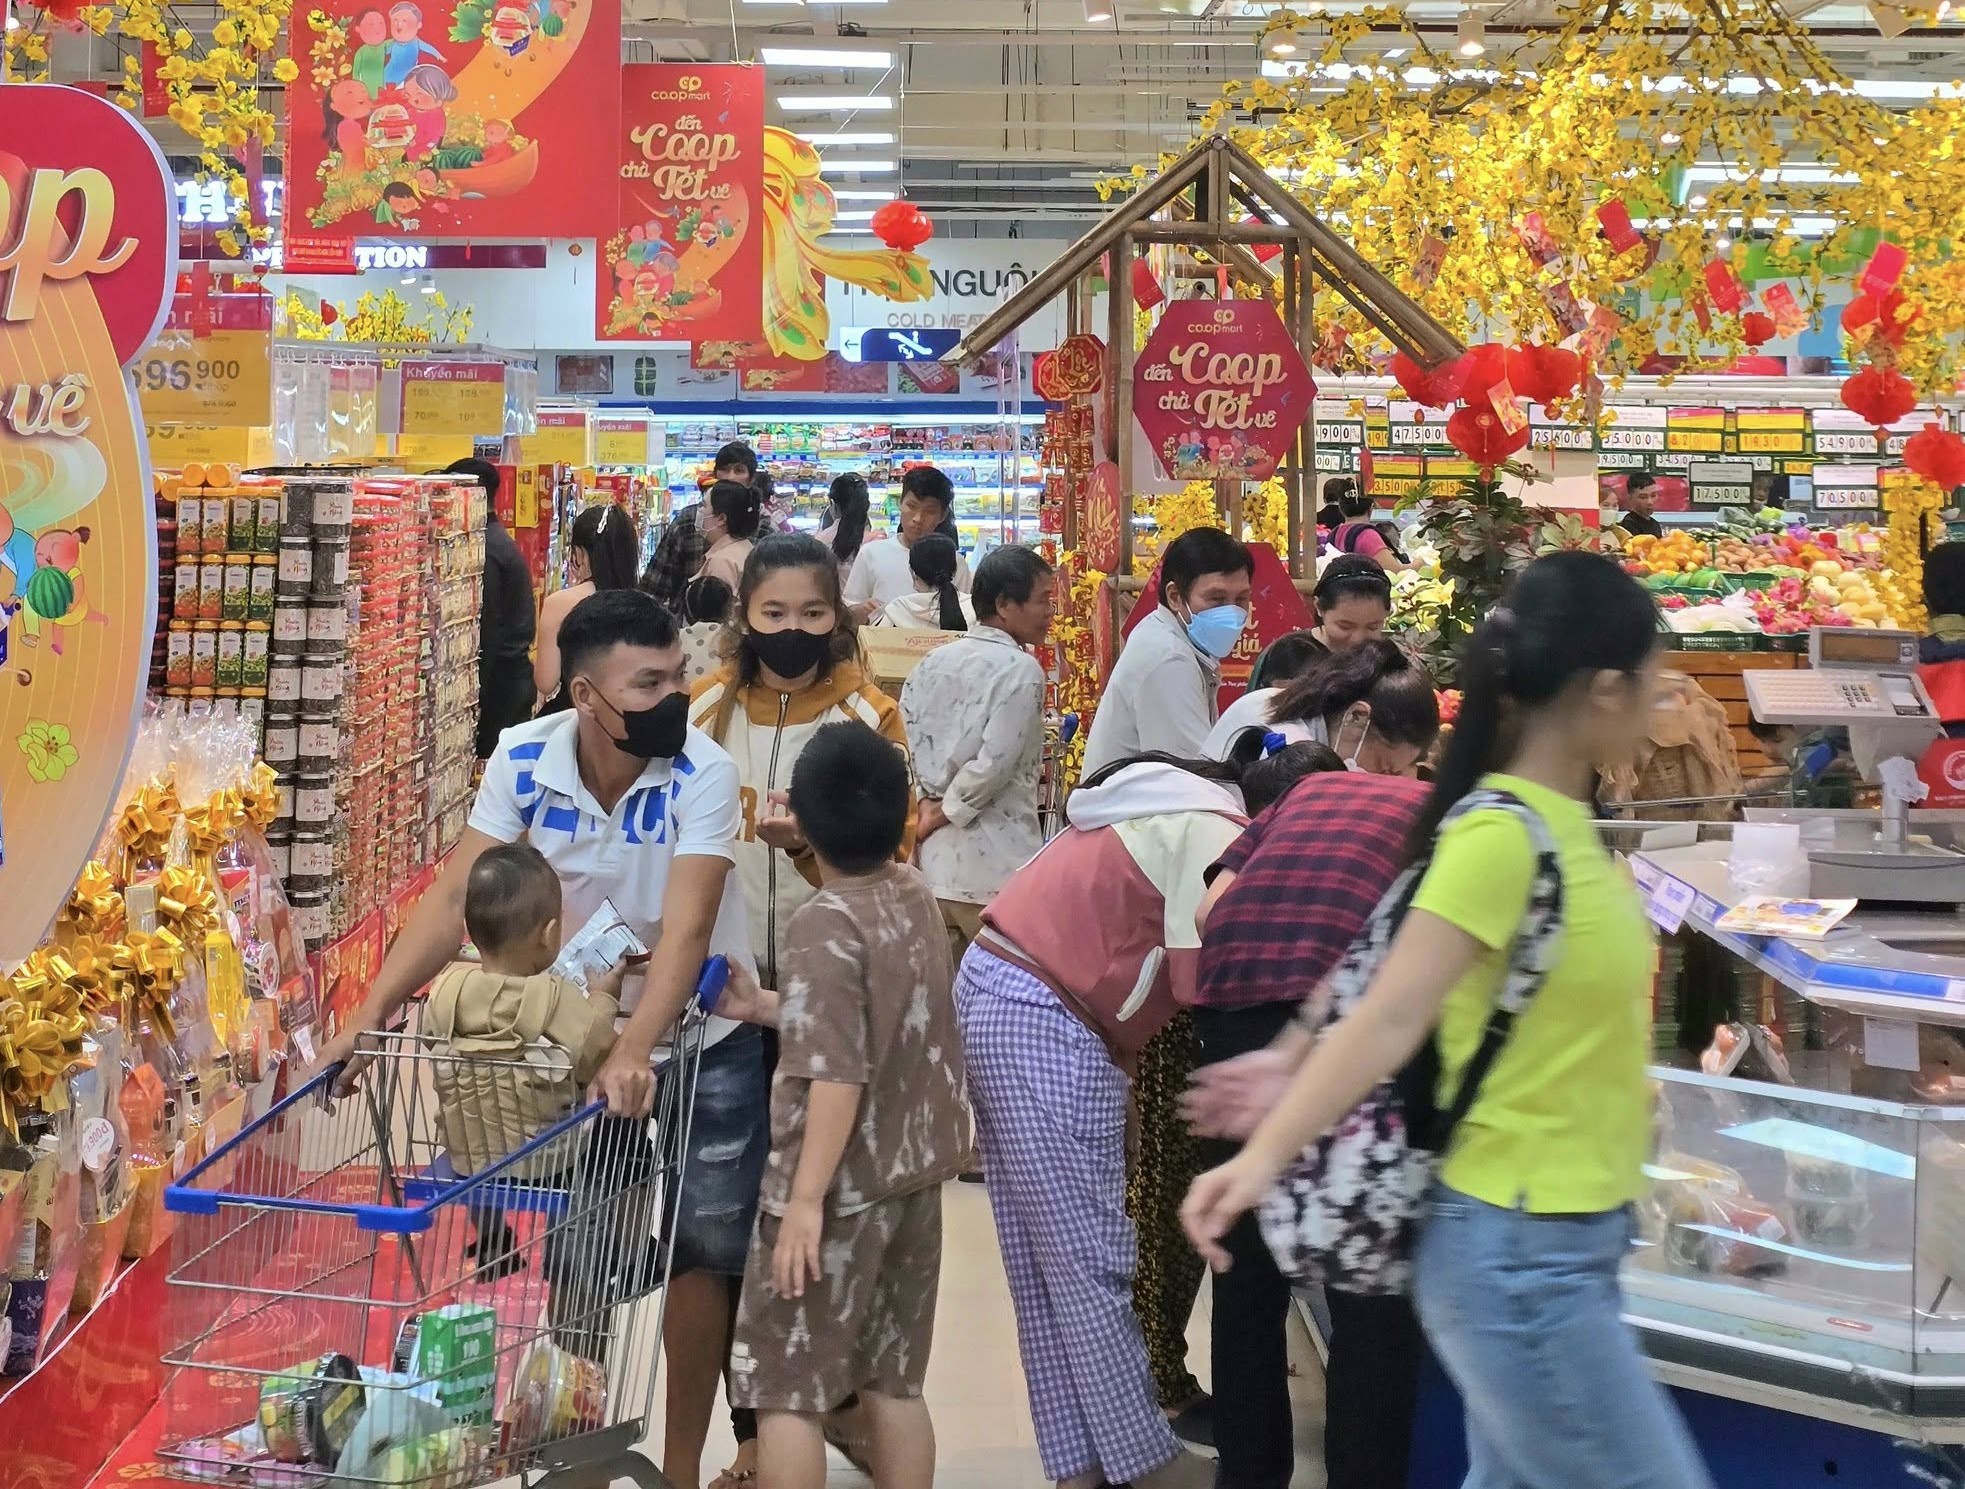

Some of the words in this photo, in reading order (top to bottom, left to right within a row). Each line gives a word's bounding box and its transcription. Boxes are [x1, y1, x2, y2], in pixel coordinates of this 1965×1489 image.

[0, 168, 139, 321] p
[887, 313, 935, 328] COLD
[1316, 424, 1350, 440] 900
